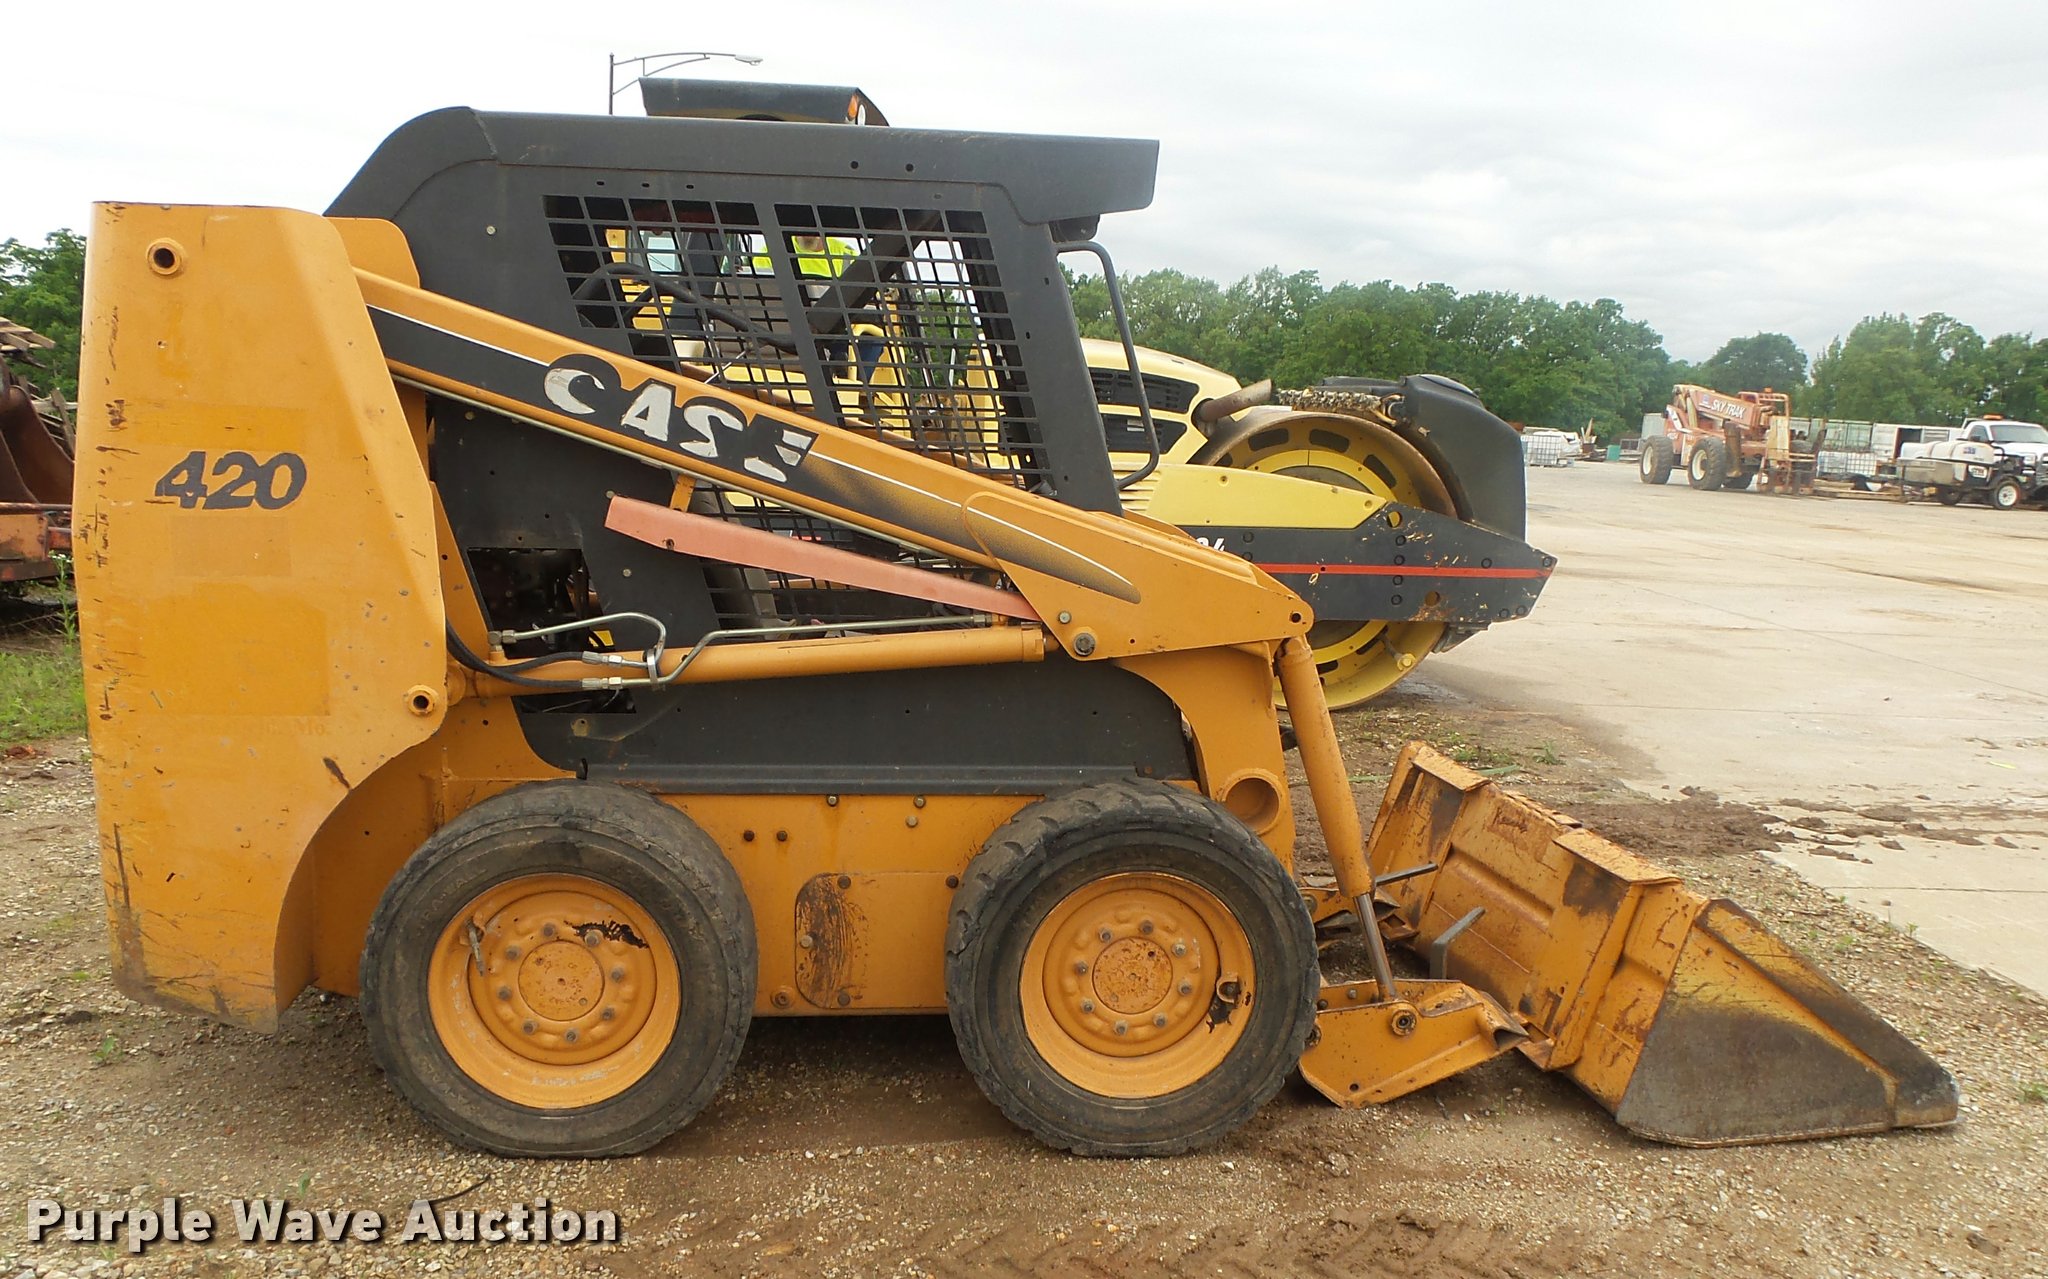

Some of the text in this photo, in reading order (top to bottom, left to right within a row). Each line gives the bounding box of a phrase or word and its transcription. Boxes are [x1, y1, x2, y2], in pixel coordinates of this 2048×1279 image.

[1711, 399, 1746, 419] SKY TRAK
[154, 450, 308, 511] 420
